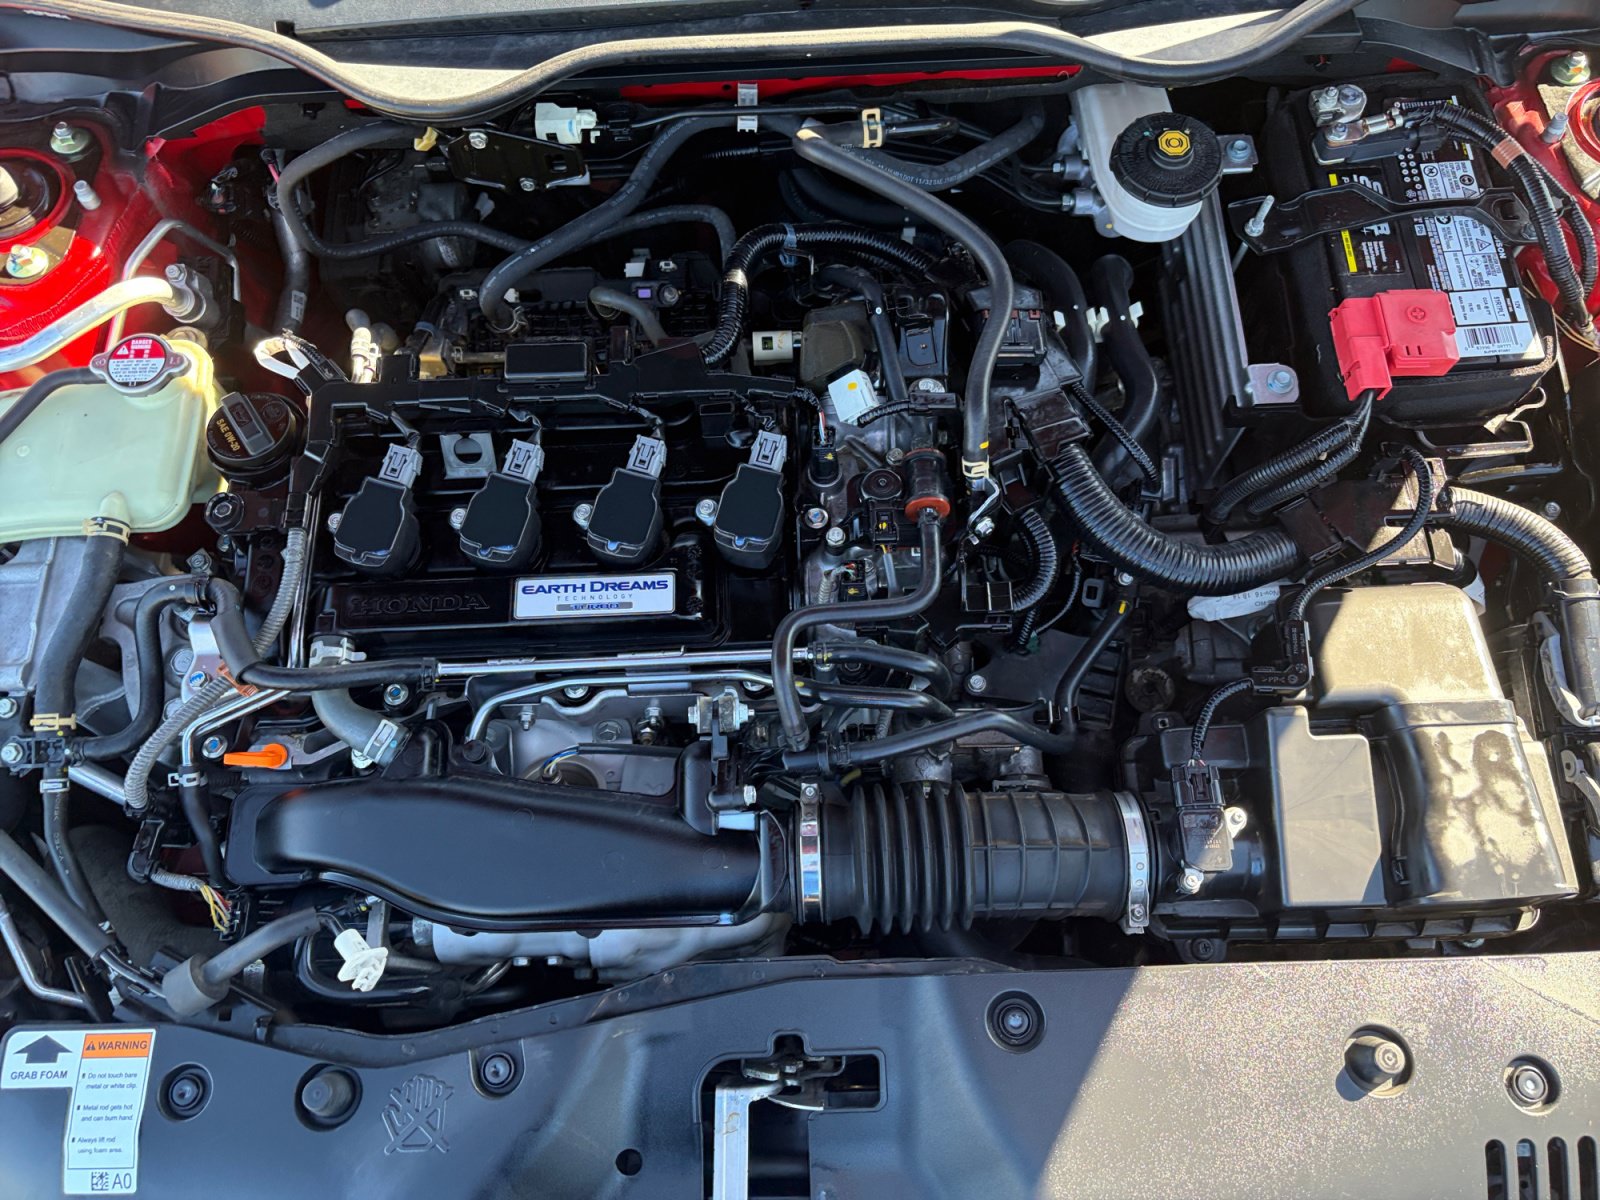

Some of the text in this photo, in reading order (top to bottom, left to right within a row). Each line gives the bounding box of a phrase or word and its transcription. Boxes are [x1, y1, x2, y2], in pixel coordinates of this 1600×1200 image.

[216, 418, 240, 452] SAE 0W-20
[522, 580, 668, 594] EARTH DREAMS
[349, 594, 490, 617] HONDA
[98, 1040, 148, 1050] WARNING
[10, 1070, 68, 1080] GRAB FOAM
[112, 1173, 132, 1189] A0
